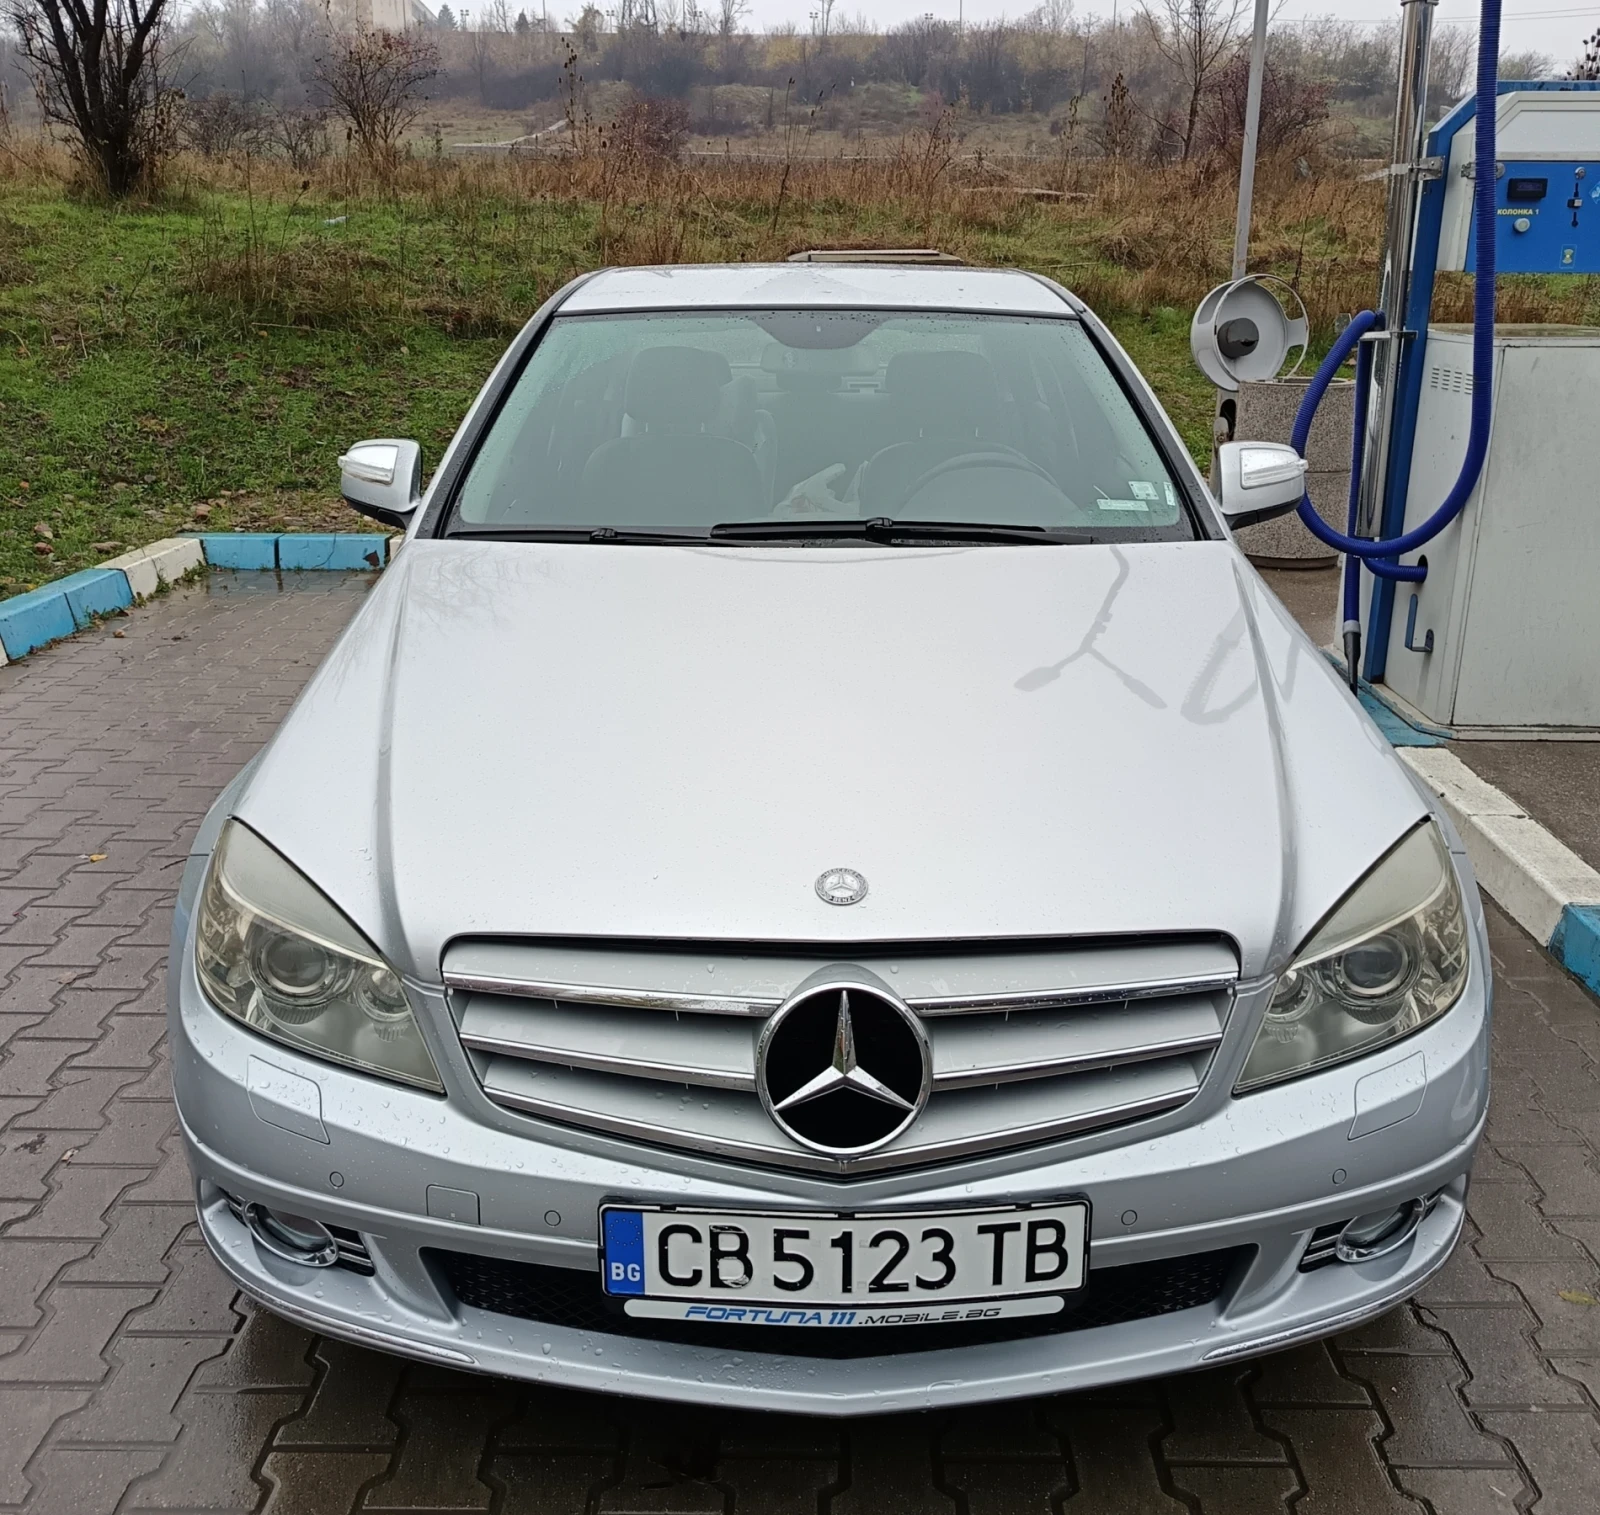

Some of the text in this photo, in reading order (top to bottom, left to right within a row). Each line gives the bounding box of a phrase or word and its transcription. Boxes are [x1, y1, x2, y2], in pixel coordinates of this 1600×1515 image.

[658, 1218, 1069, 1293] CB 5123 TB
[611, 1262, 641, 1282] BG
[685, 1305, 822, 1325] FORTUNA
